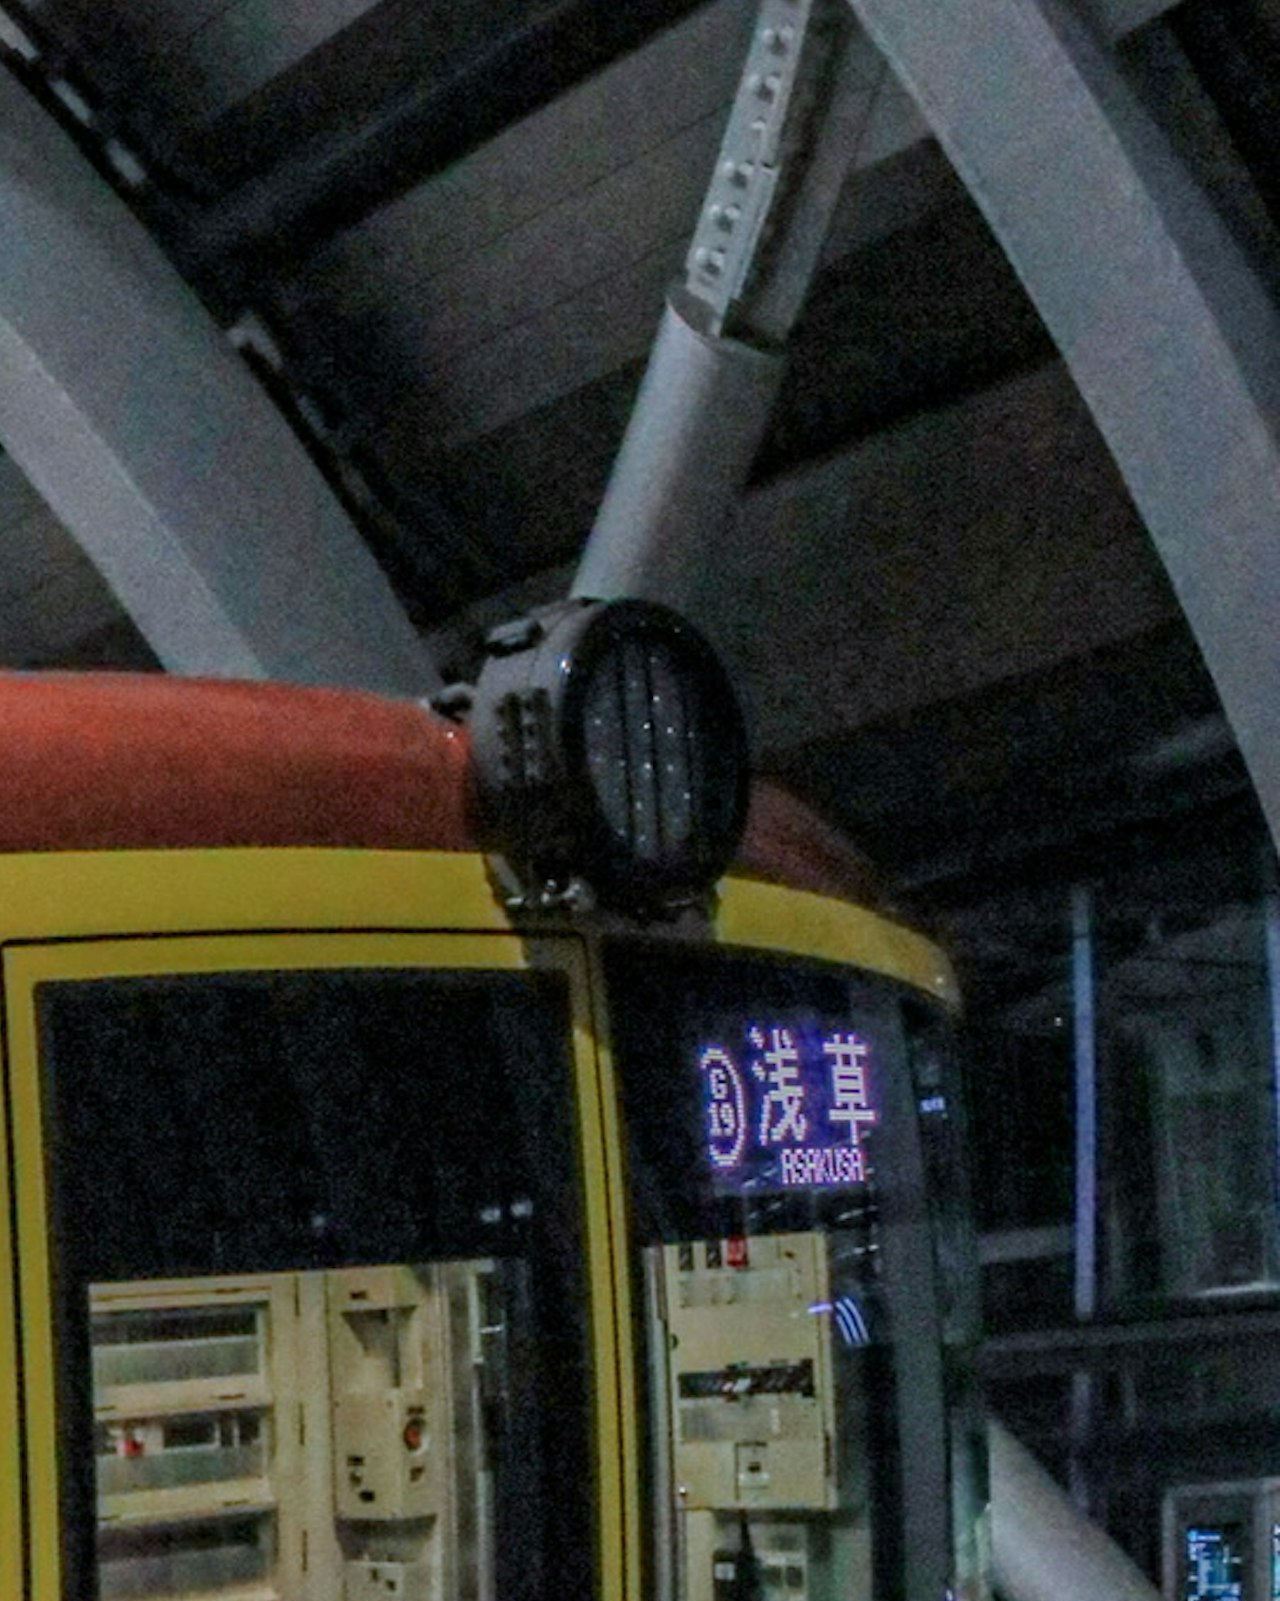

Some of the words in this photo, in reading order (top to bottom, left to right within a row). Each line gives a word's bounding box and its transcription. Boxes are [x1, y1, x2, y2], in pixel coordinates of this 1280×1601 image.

[709, 1068, 728, 1100] G
[750, 1026, 876, 1145] 浅草
[709, 1102, 735, 1137] 19
[781, 1148, 865, 1185] ASAKUSA
